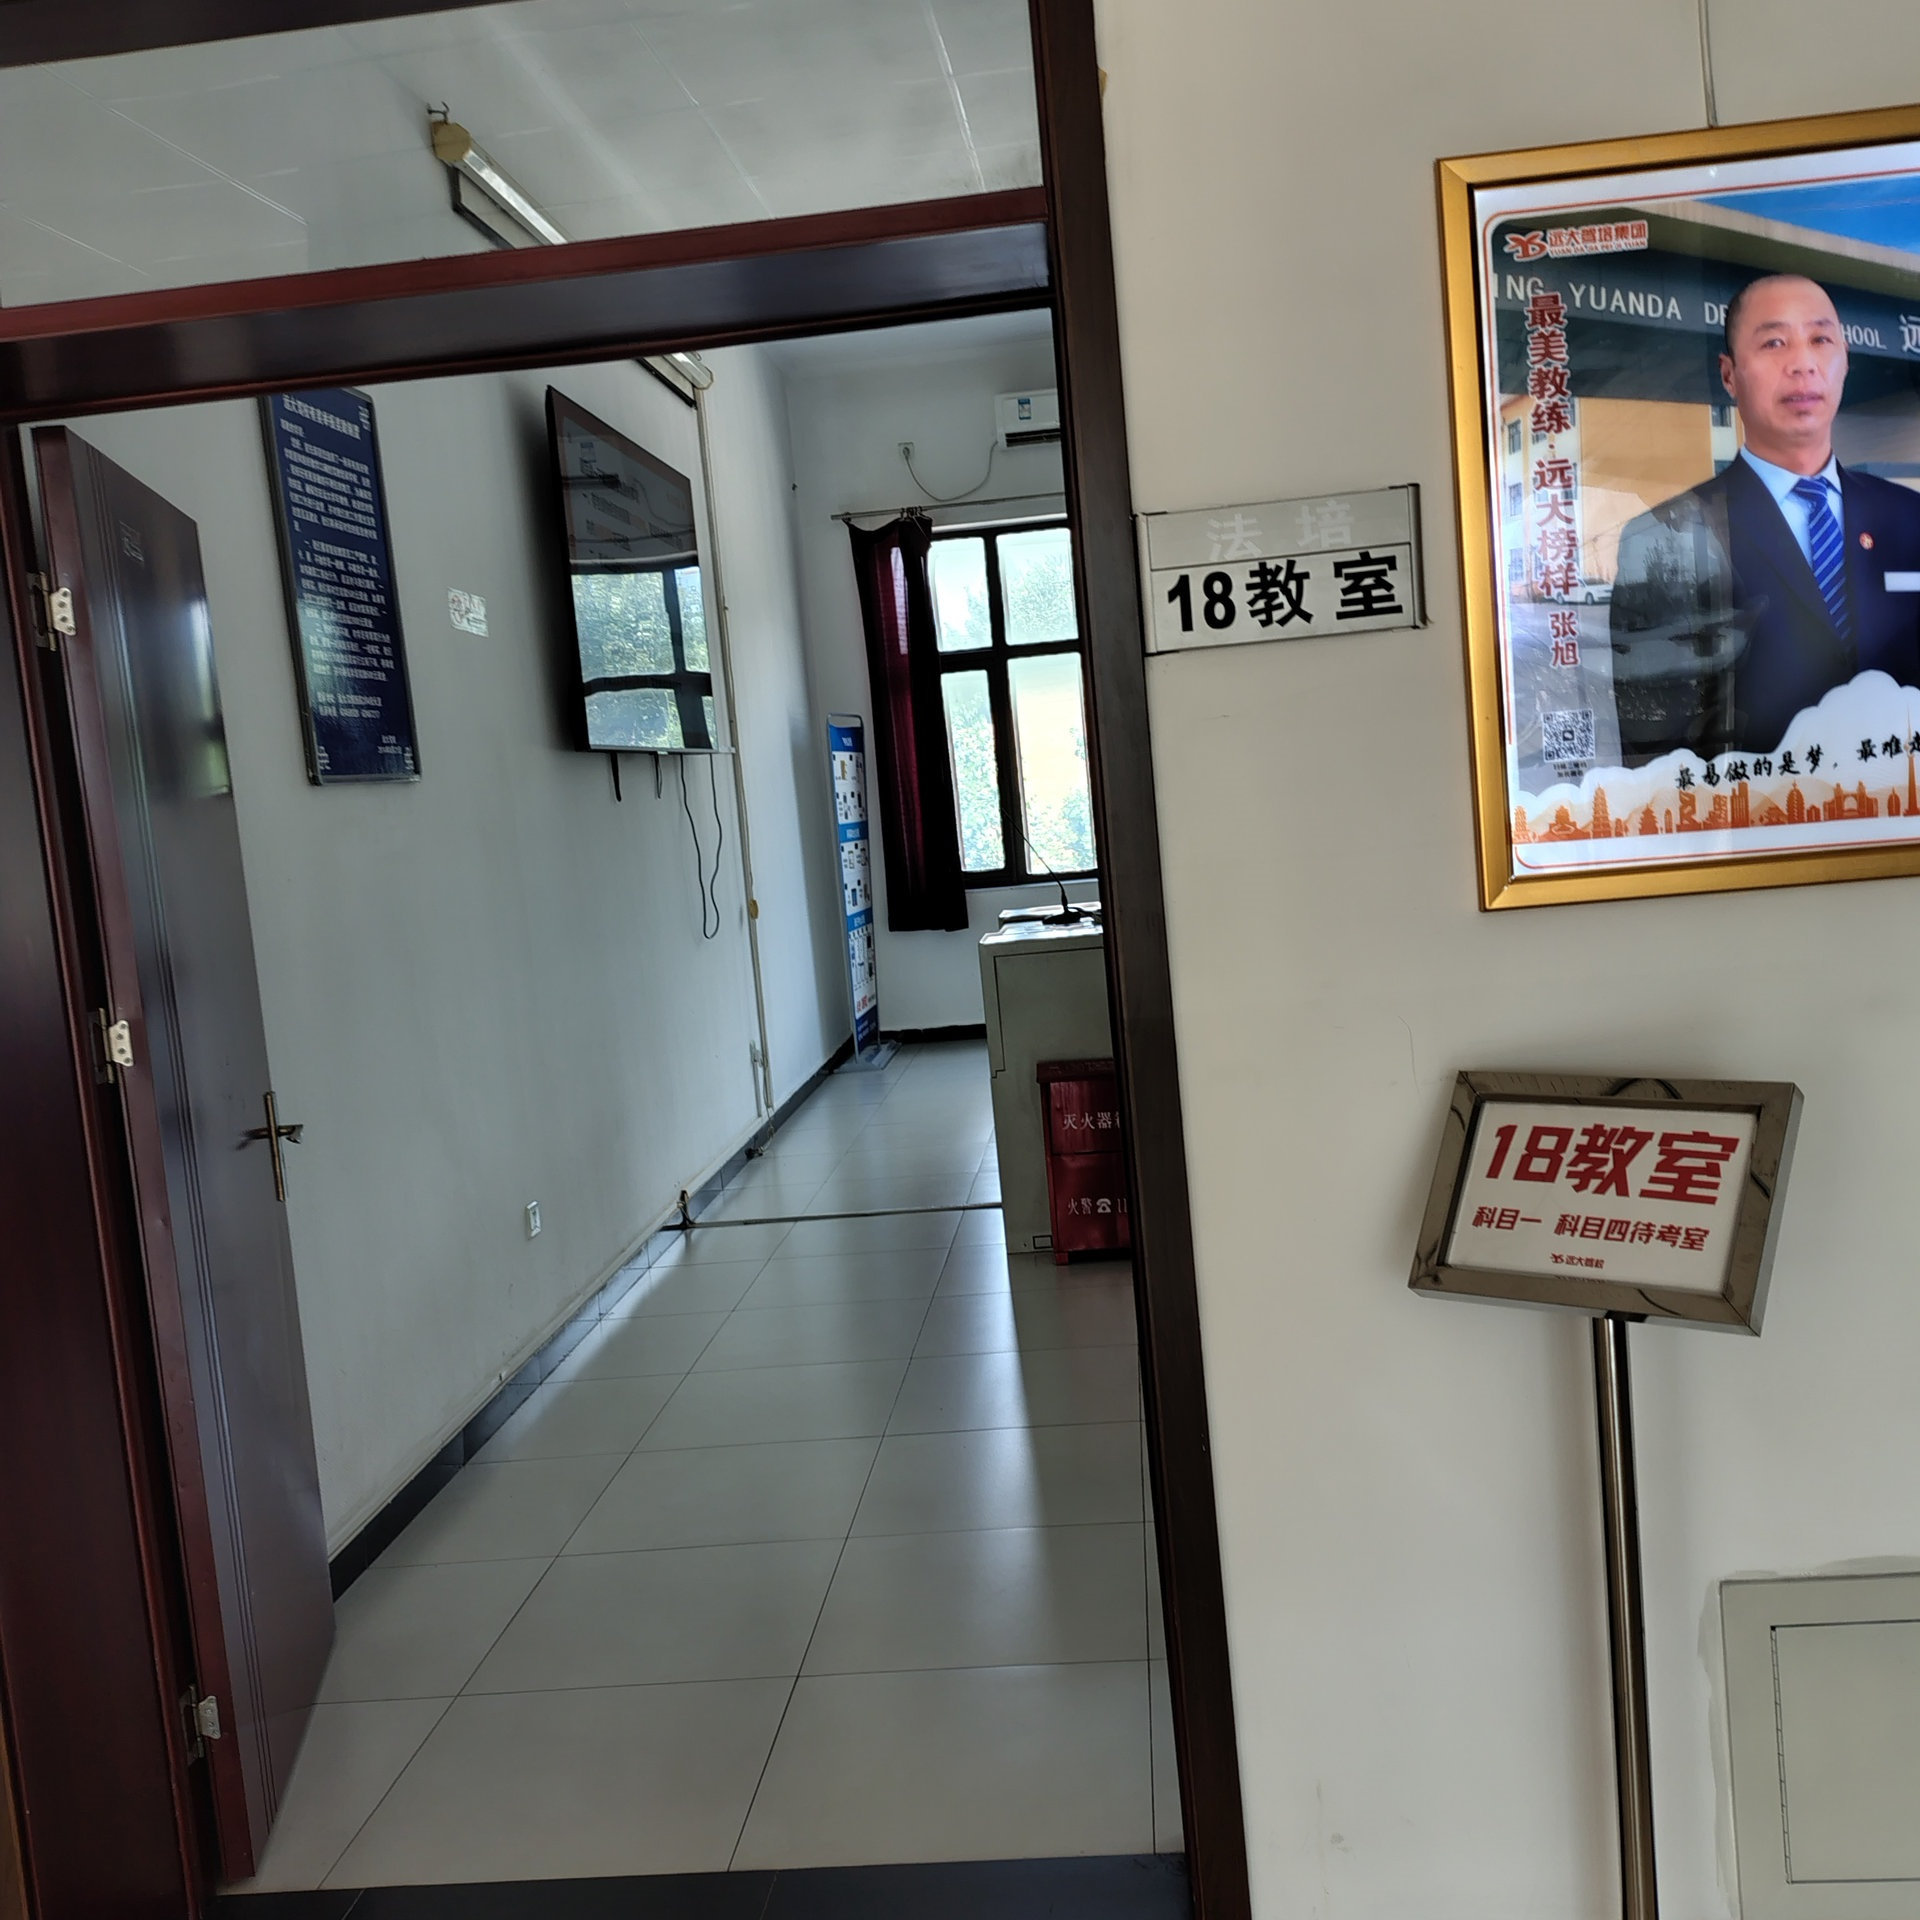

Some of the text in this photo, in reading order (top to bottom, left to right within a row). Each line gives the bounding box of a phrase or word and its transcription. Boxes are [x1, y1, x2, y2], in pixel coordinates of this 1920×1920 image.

[1568, 281, 1682, 321] YUANDA
[1167, 551, 1404, 633] 18教室
[1548, 610, 1581, 668] 张旭
[1062, 1111, 1121, 1130] 灭火器
[1485, 1123, 1740, 1206] 18教室
[1471, 1205, 1710, 1252] 科目一 科目四待考室
